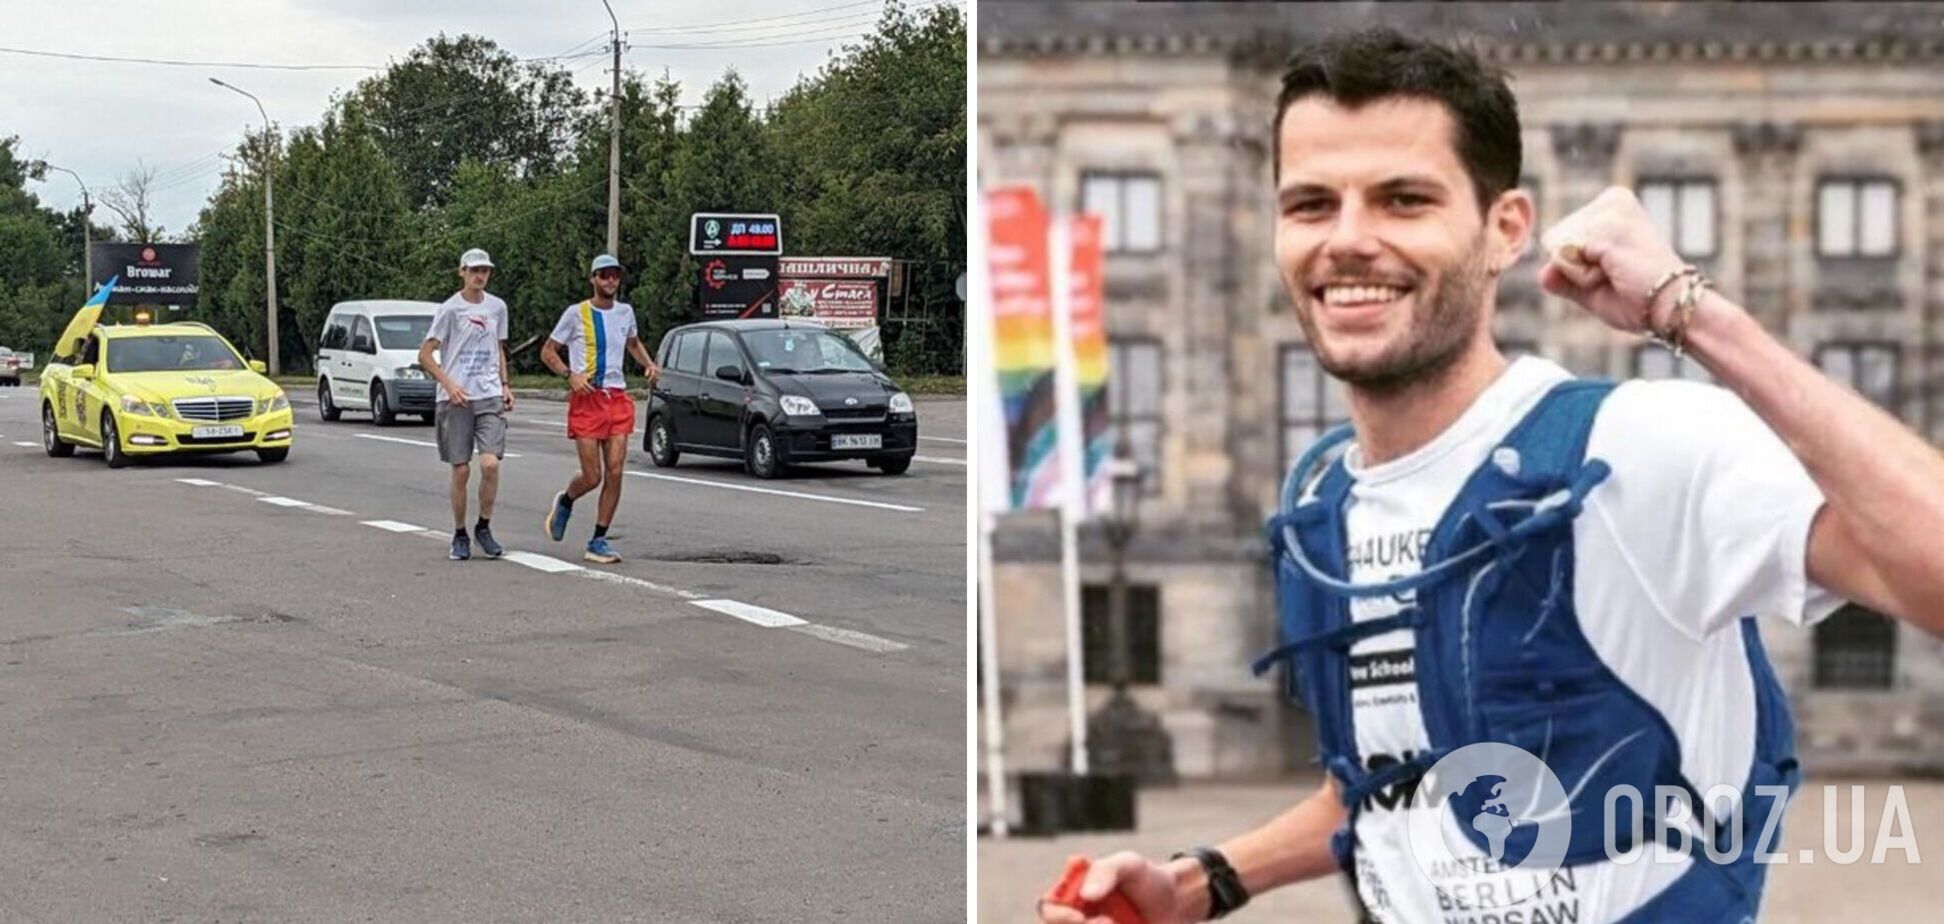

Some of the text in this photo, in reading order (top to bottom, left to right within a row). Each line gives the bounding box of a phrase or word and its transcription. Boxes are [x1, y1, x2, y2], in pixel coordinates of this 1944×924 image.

[126, 265, 173, 278] Browar
[1370, 656, 1414, 679] School
[1435, 866, 1577, 910] BERLIN
